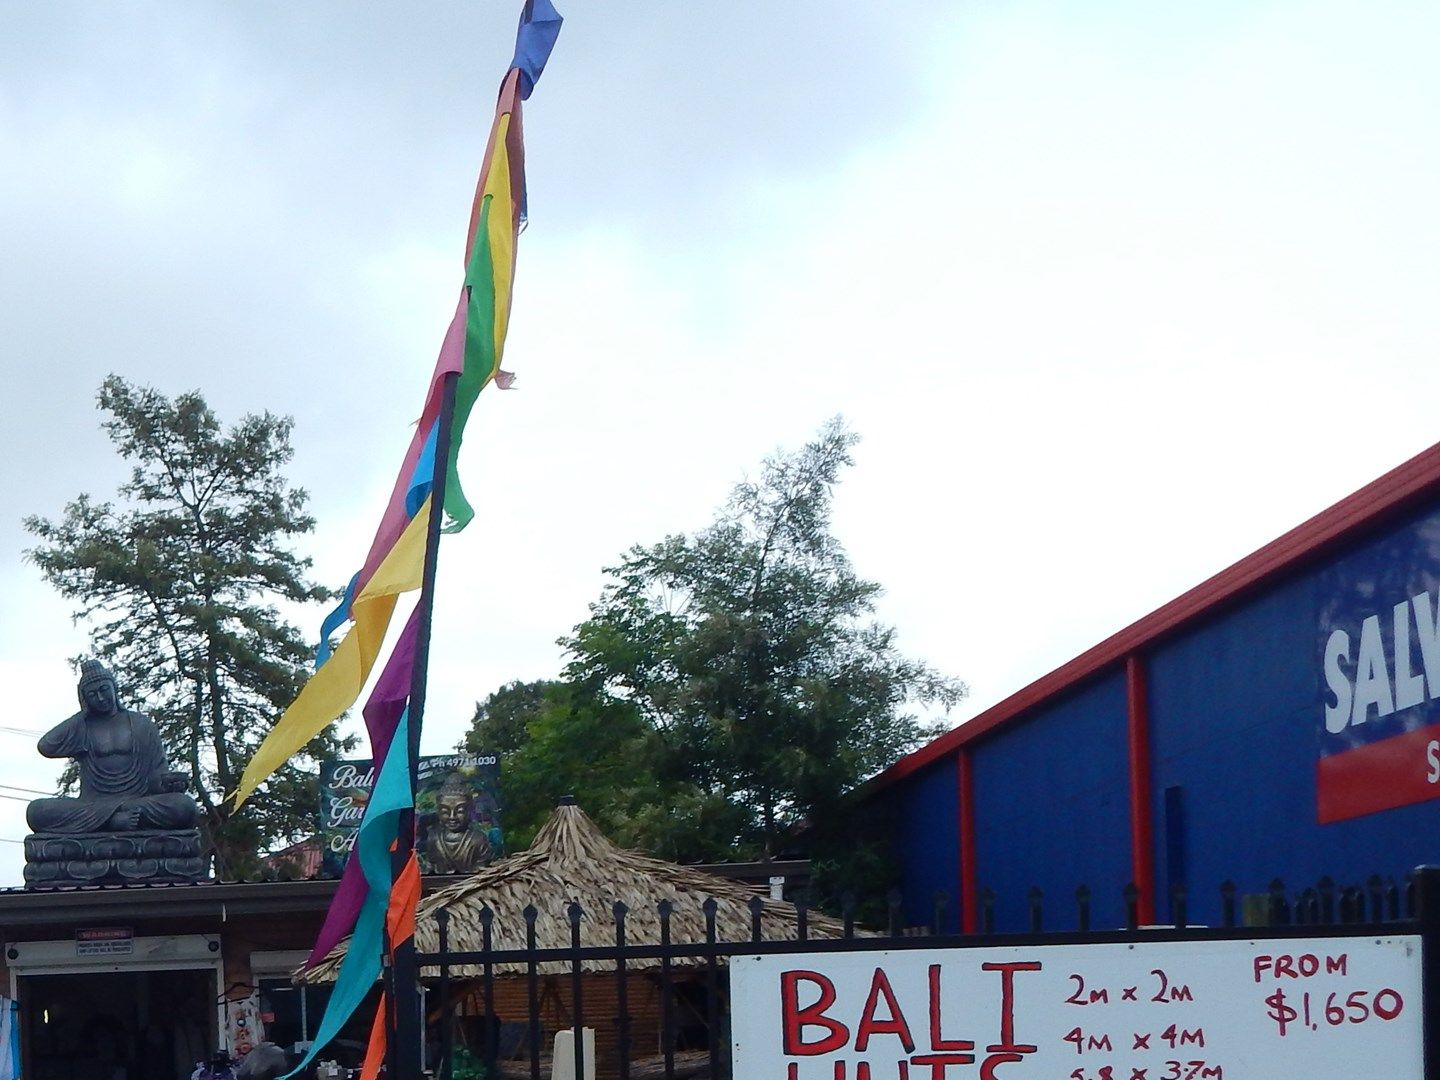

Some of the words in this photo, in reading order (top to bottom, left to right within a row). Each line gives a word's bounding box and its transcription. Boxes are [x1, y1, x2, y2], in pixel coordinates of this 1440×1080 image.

[327, 796, 365, 828] Gar
[1253, 953, 1348, 982] FROM
[780, 961, 1042, 1056] BALI
[1265, 987, 1404, 1036] $1,650
